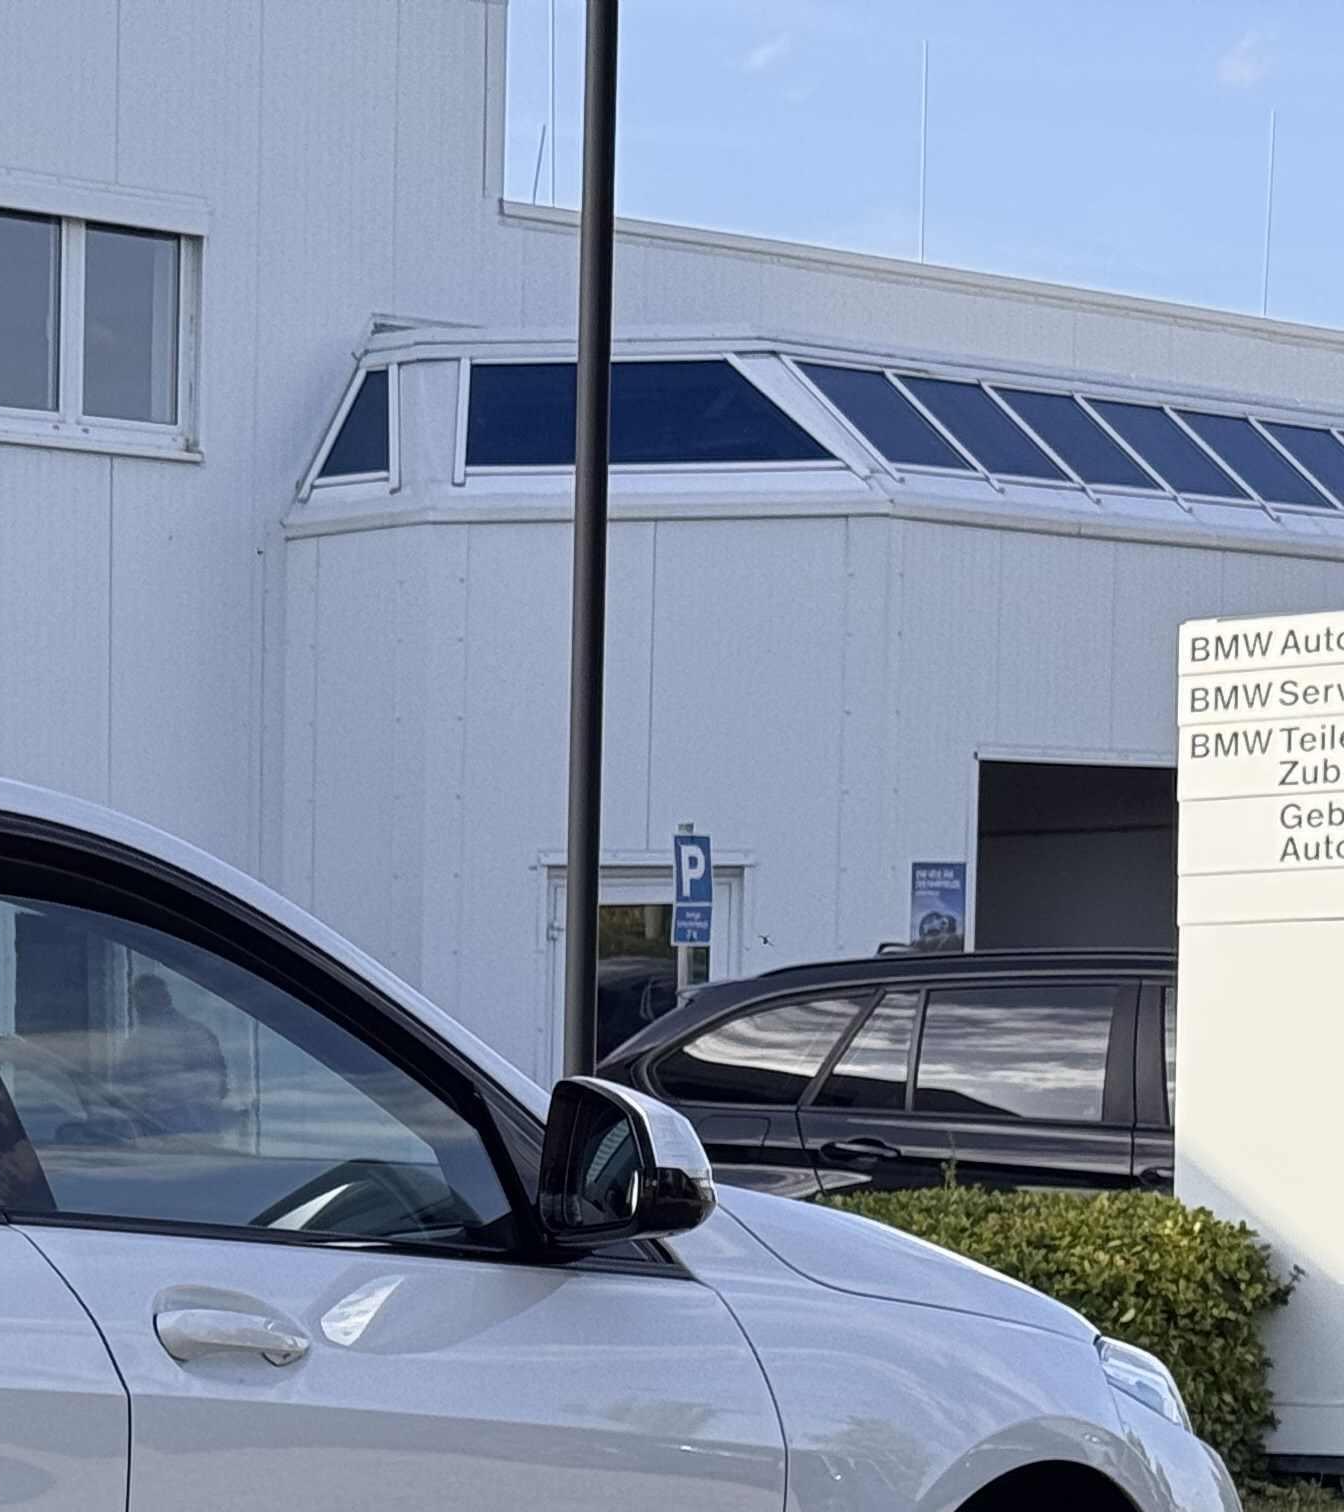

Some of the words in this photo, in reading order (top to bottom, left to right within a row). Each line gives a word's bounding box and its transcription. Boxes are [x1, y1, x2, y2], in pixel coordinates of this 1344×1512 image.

[1190, 631, 1273, 662] BMW
[1190, 682, 1273, 713] BMW
[1190, 728, 1273, 759] BMW
[1279, 724, 1344, 753] Teil
[680, 845, 705, 897] P
